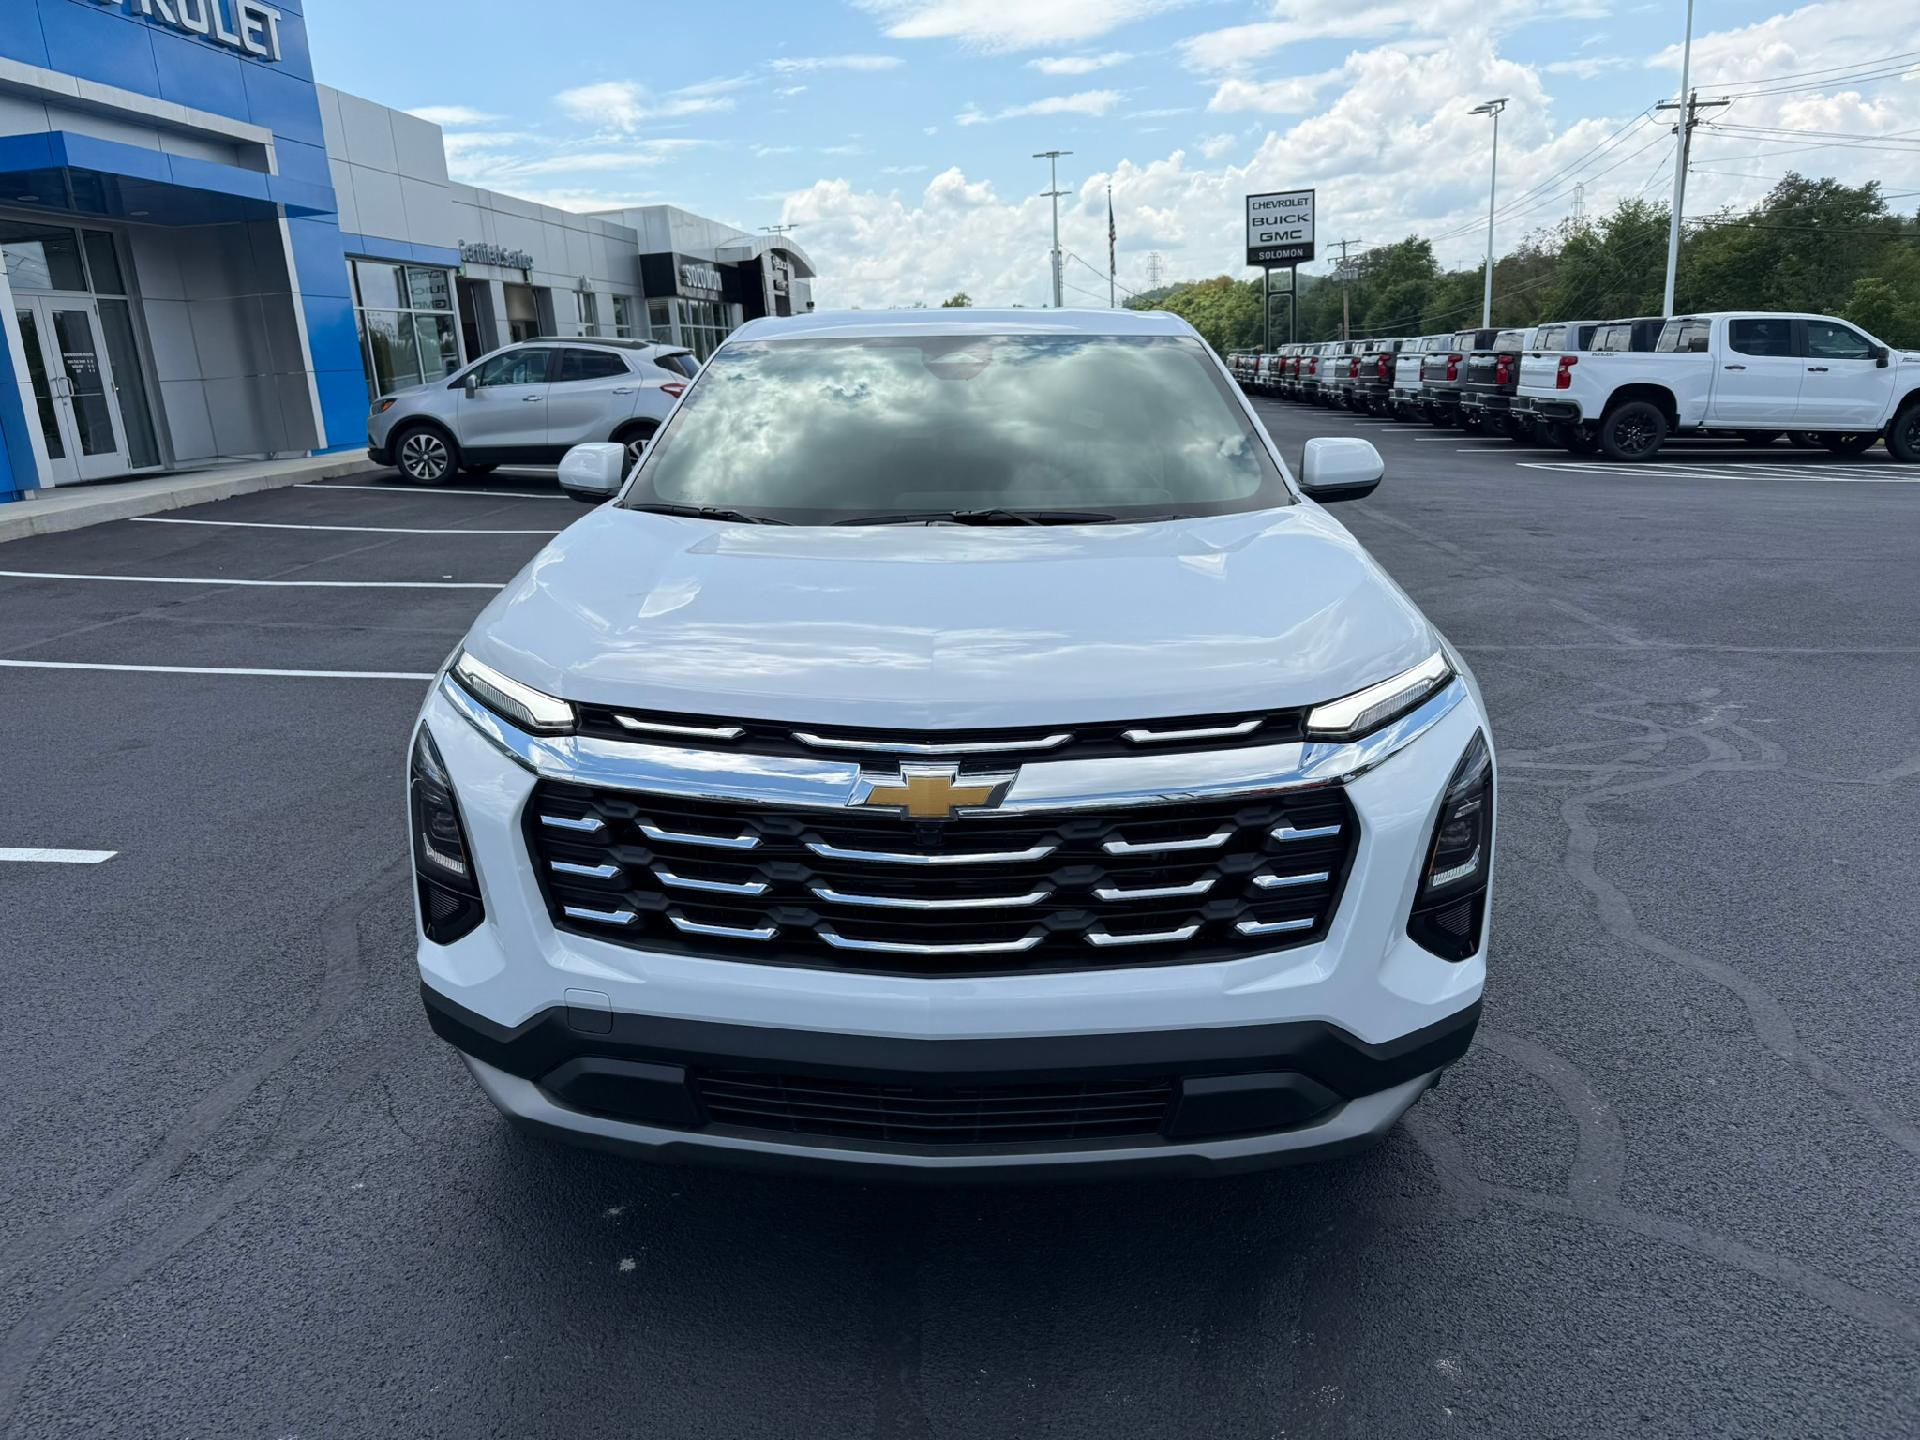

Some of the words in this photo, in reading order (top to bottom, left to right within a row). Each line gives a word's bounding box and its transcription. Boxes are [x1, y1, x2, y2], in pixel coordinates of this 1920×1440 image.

[1252, 197, 1309, 211] CHEVROLET
[1252, 213, 1310, 227] BUICK
[1259, 229, 1303, 242] GMC
[1258, 247, 1304, 261] SOLOMON
